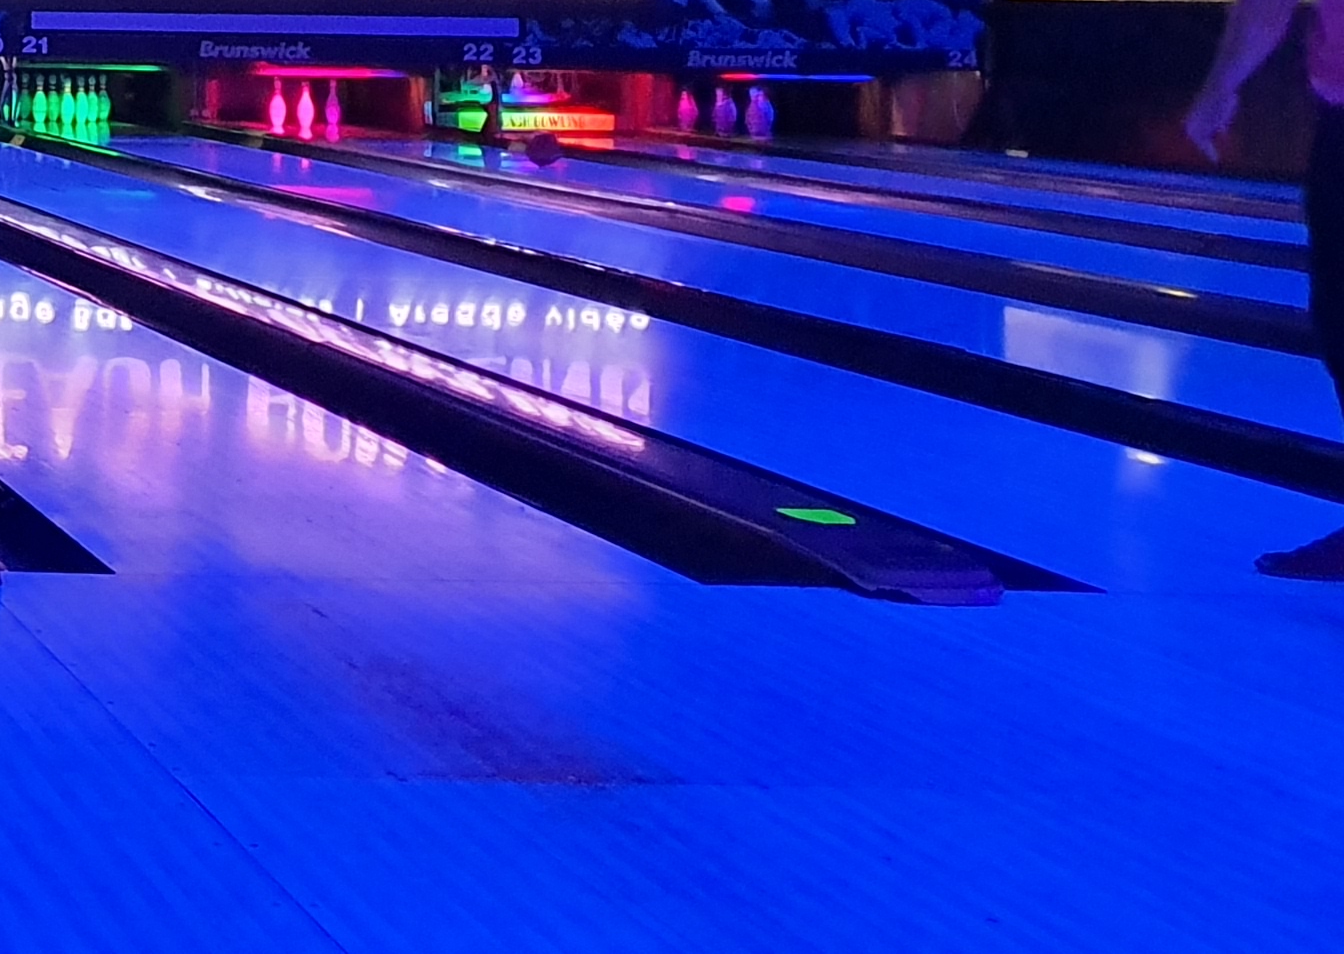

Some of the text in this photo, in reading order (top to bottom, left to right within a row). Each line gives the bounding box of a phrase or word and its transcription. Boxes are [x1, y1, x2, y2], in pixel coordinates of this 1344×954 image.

[21, 36, 48, 54] 21
[199, 40, 311, 60] Brunswick
[462, 43, 495, 62] 22
[512, 47, 543, 65] 23
[686, 49, 798, 68] Brunswick
[948, 49, 978, 68] 24
